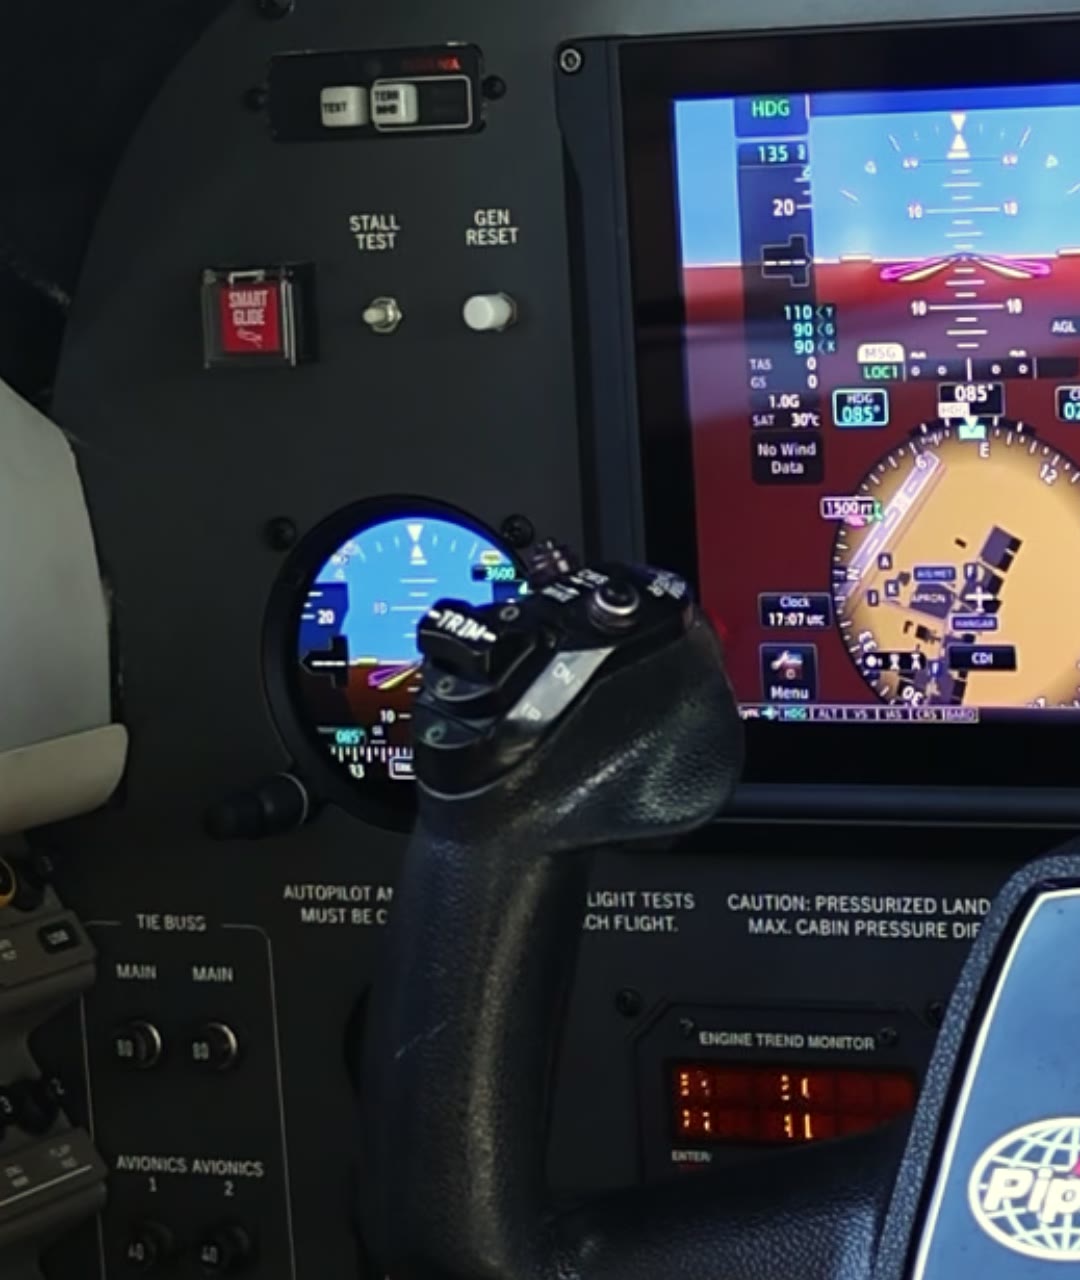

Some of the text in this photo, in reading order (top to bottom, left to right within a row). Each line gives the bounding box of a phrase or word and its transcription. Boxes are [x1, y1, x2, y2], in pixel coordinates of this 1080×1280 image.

[752, 100, 790, 117] HDG
[758, 145, 789, 162] 135
[349, 215, 400, 231] STALL
[474, 209, 510, 226] GEN
[356, 233, 396, 250] TEST
[466, 227, 519, 245] RESET
[229, 290, 268, 308] SMART
[784, 304, 813, 320] 110
[757, 441, 816, 458] No Wind
[771, 460, 804, 475] Data
[771, 686, 810, 700] Menu
[284, 885, 371, 901] AUTOPILOT
[642, 893, 695, 909] TESTS
[728, 894, 937, 914] CAUTION: PRESSURIZED
[137, 914, 206, 932] TIE BUSS
[301, 907, 373, 924] MUST BE
[796, 919, 849, 935] CABIN
[854, 920, 948, 937] PRESSURE
[116, 964, 157, 980] MAIN
[192, 966, 234, 983] MAIN
[700, 1032, 875, 1050] ENGINE TREND MONITOR
[116, 1155, 187, 1172] AVIONICS
[192, 1160, 265, 1178] AVIONICS
